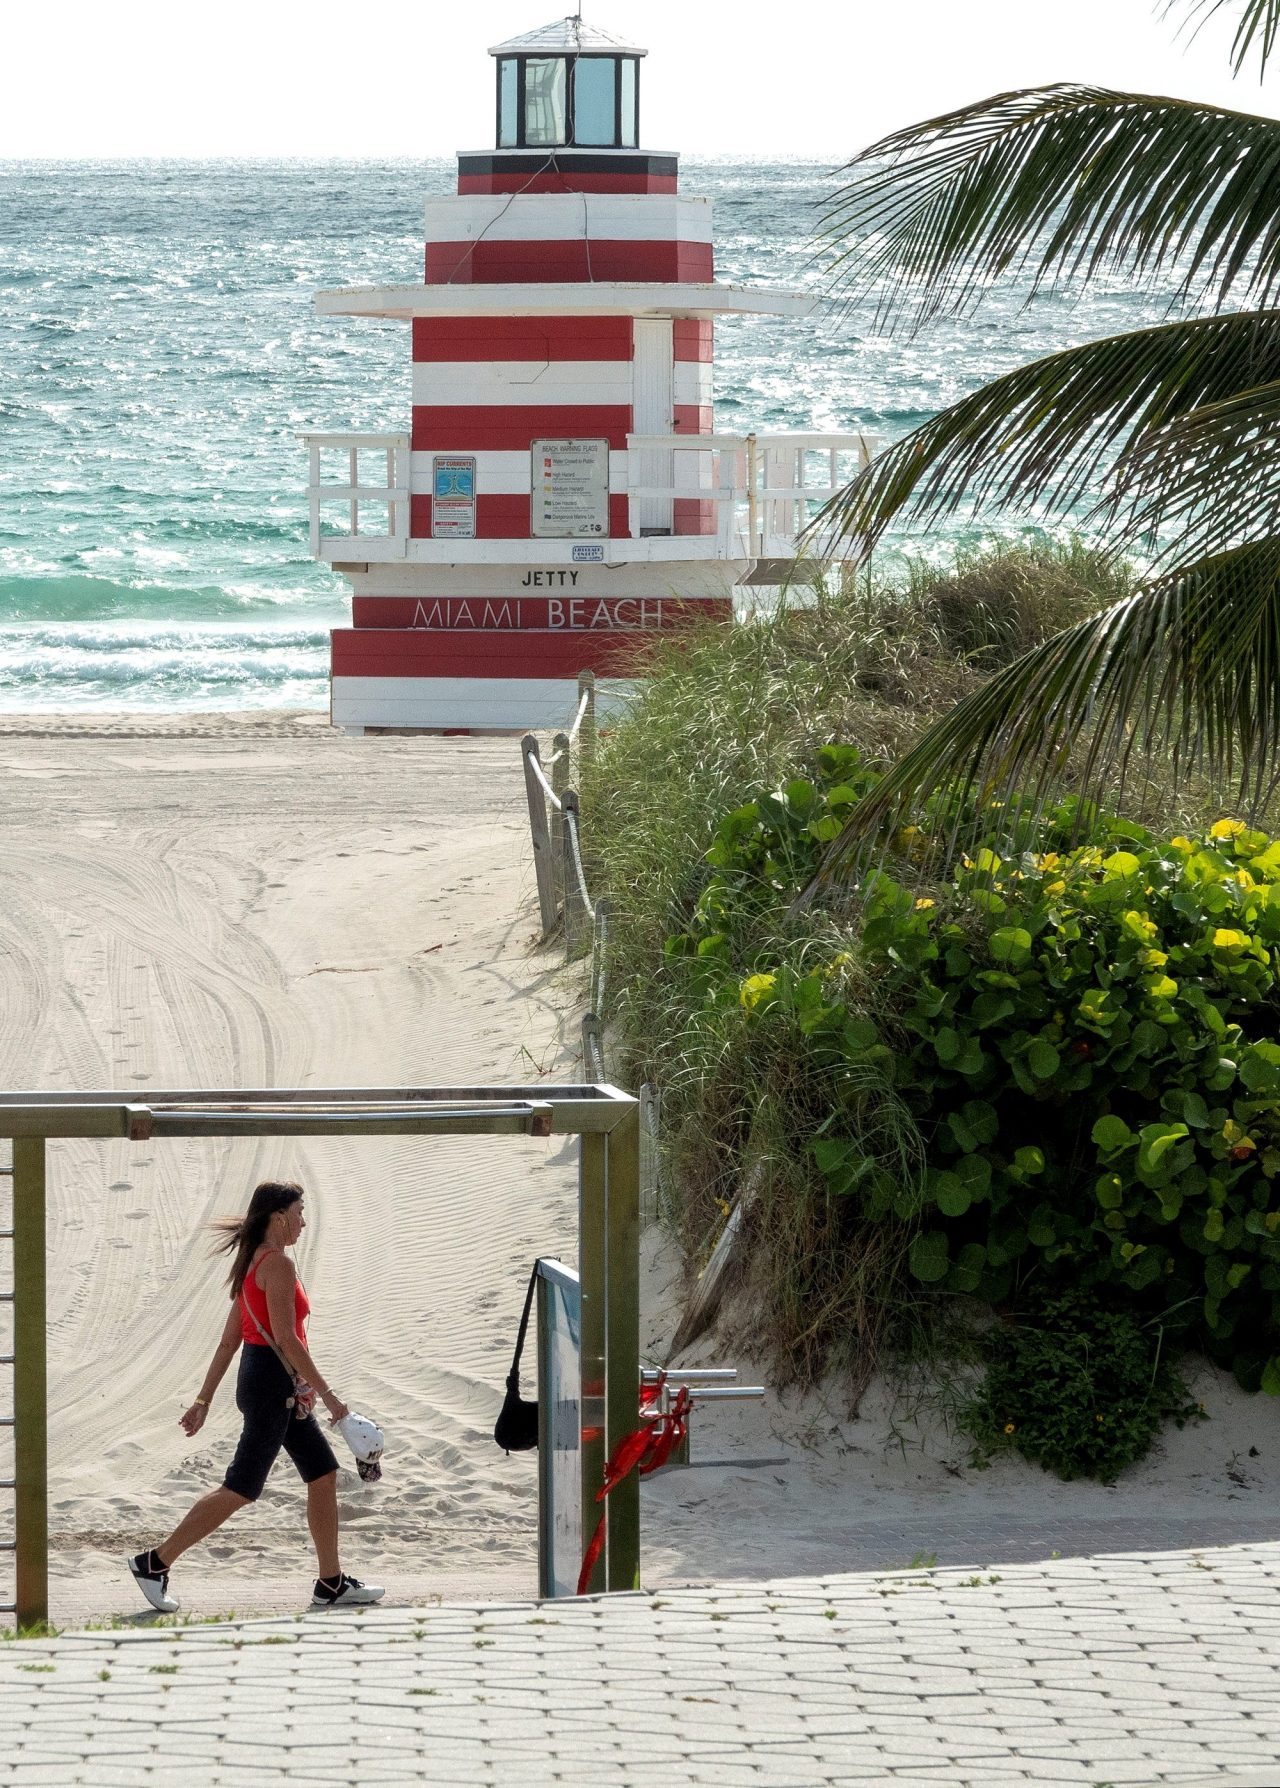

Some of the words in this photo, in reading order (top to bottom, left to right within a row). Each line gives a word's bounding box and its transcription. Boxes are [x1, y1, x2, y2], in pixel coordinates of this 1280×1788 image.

[522, 571, 579, 586] JETTY
[412, 599, 521, 628] MIAMI
[548, 599, 663, 628] BEACH
